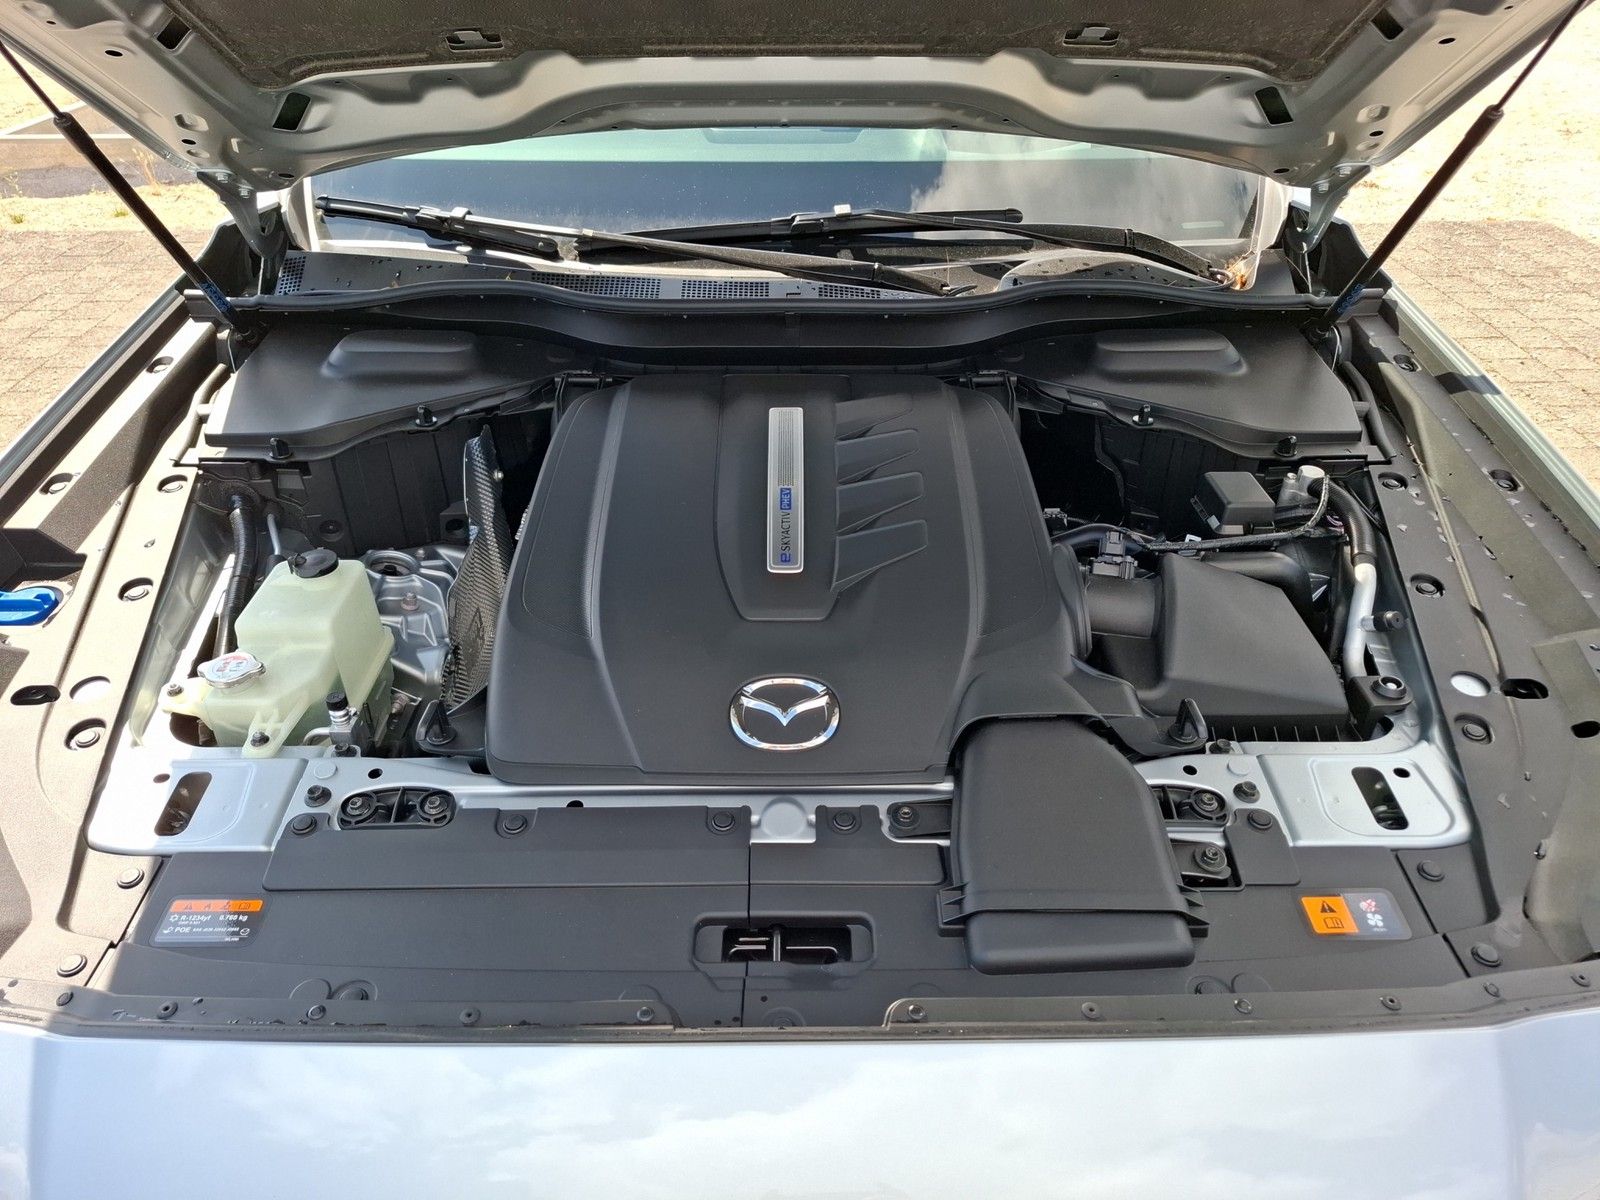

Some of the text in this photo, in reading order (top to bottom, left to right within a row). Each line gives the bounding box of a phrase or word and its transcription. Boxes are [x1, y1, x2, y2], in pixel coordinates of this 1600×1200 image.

[781, 487, 791, 509] PHEV
[780, 511, 791, 552] SKYACTIV
[180, 914, 212, 922] R-1234yf
[238, 914, 249, 922] kg
